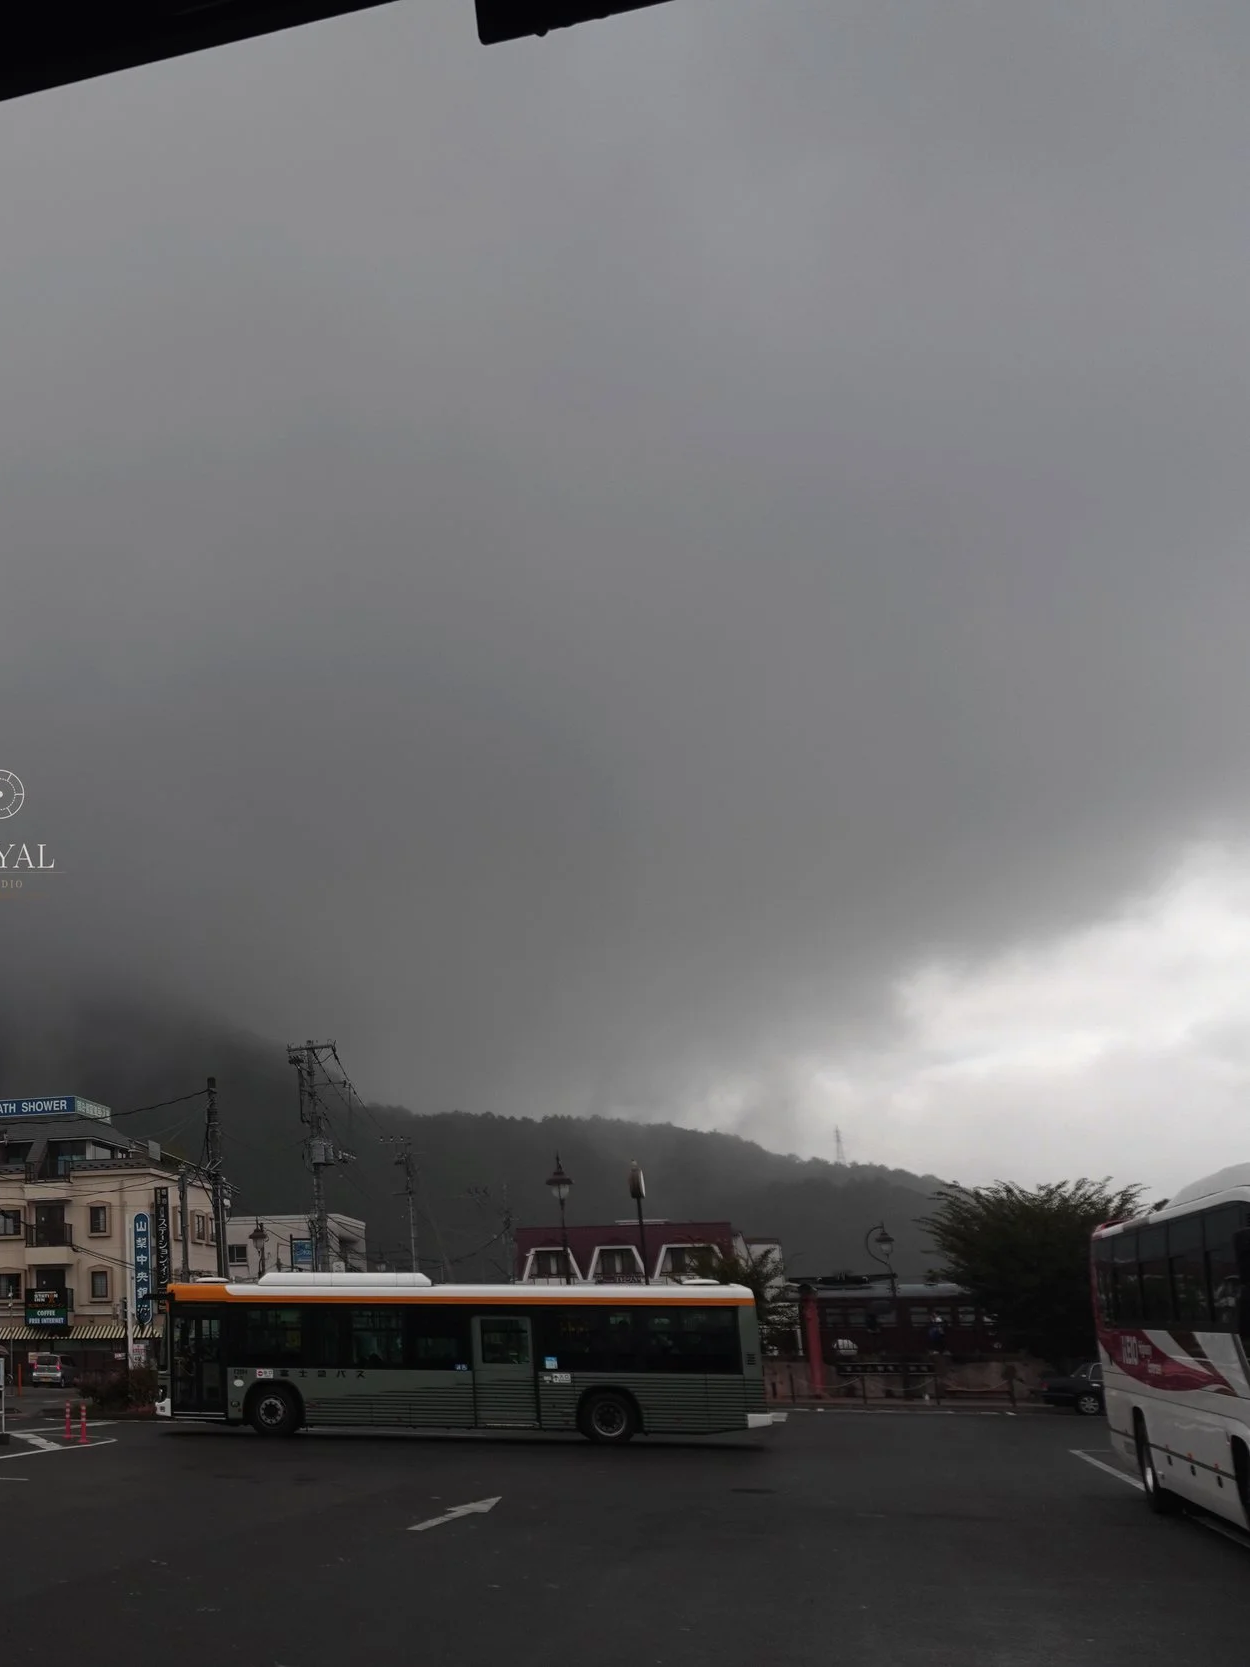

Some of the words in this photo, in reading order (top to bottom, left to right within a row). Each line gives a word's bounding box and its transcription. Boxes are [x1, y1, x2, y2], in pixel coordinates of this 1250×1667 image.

[21, 1100, 68, 1112] SHOWER
[279, 1369, 365, 1378] 富士急バス
